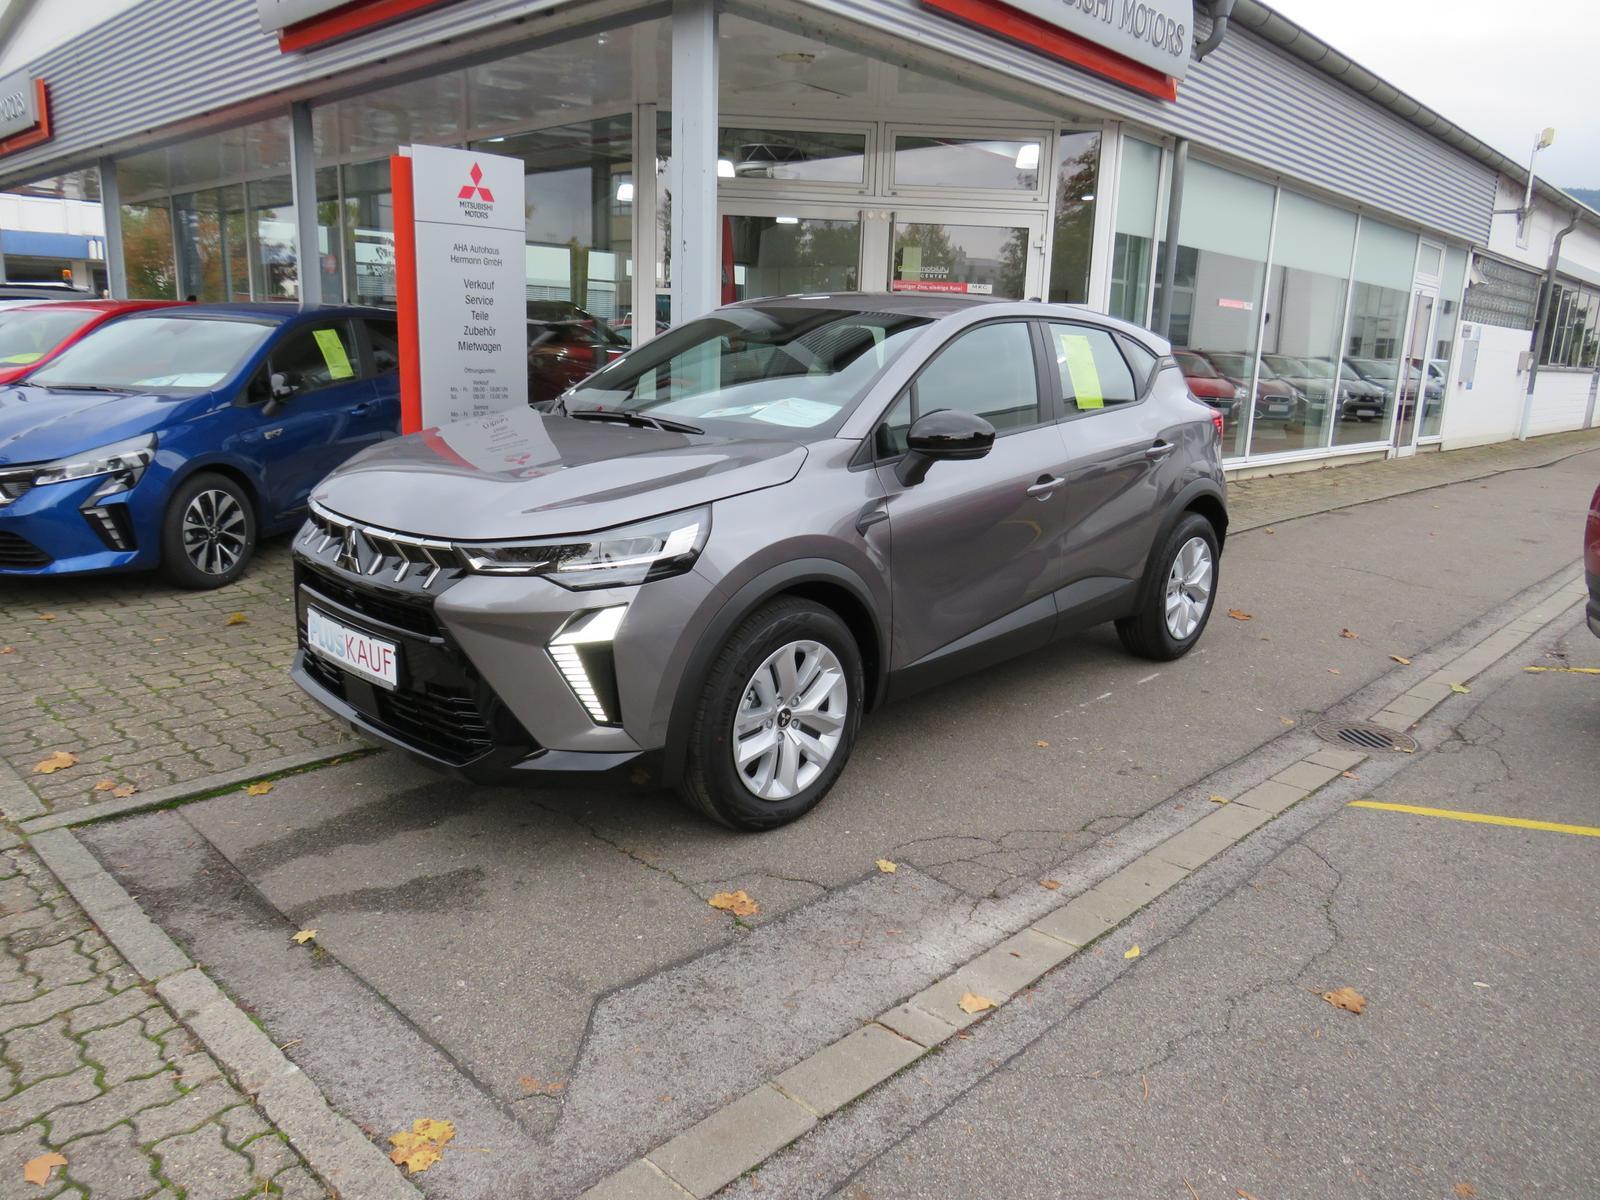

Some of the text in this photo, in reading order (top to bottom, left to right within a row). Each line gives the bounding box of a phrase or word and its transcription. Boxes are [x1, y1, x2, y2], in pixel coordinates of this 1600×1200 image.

[1118, 0, 1184, 57] MOTORS
[459, 201, 493, 211] MITSUBISHI
[464, 210, 489, 219] MOTORS
[453, 243, 500, 255] AHA Autohaus
[450, 255, 503, 267] Hermann GmbH
[463, 279, 495, 290] Verkauf
[465, 295, 494, 306] Service
[471, 310, 489, 321] Teile
[463, 326, 496, 336] Zubehör
[458, 341, 502, 354] Mietwagen
